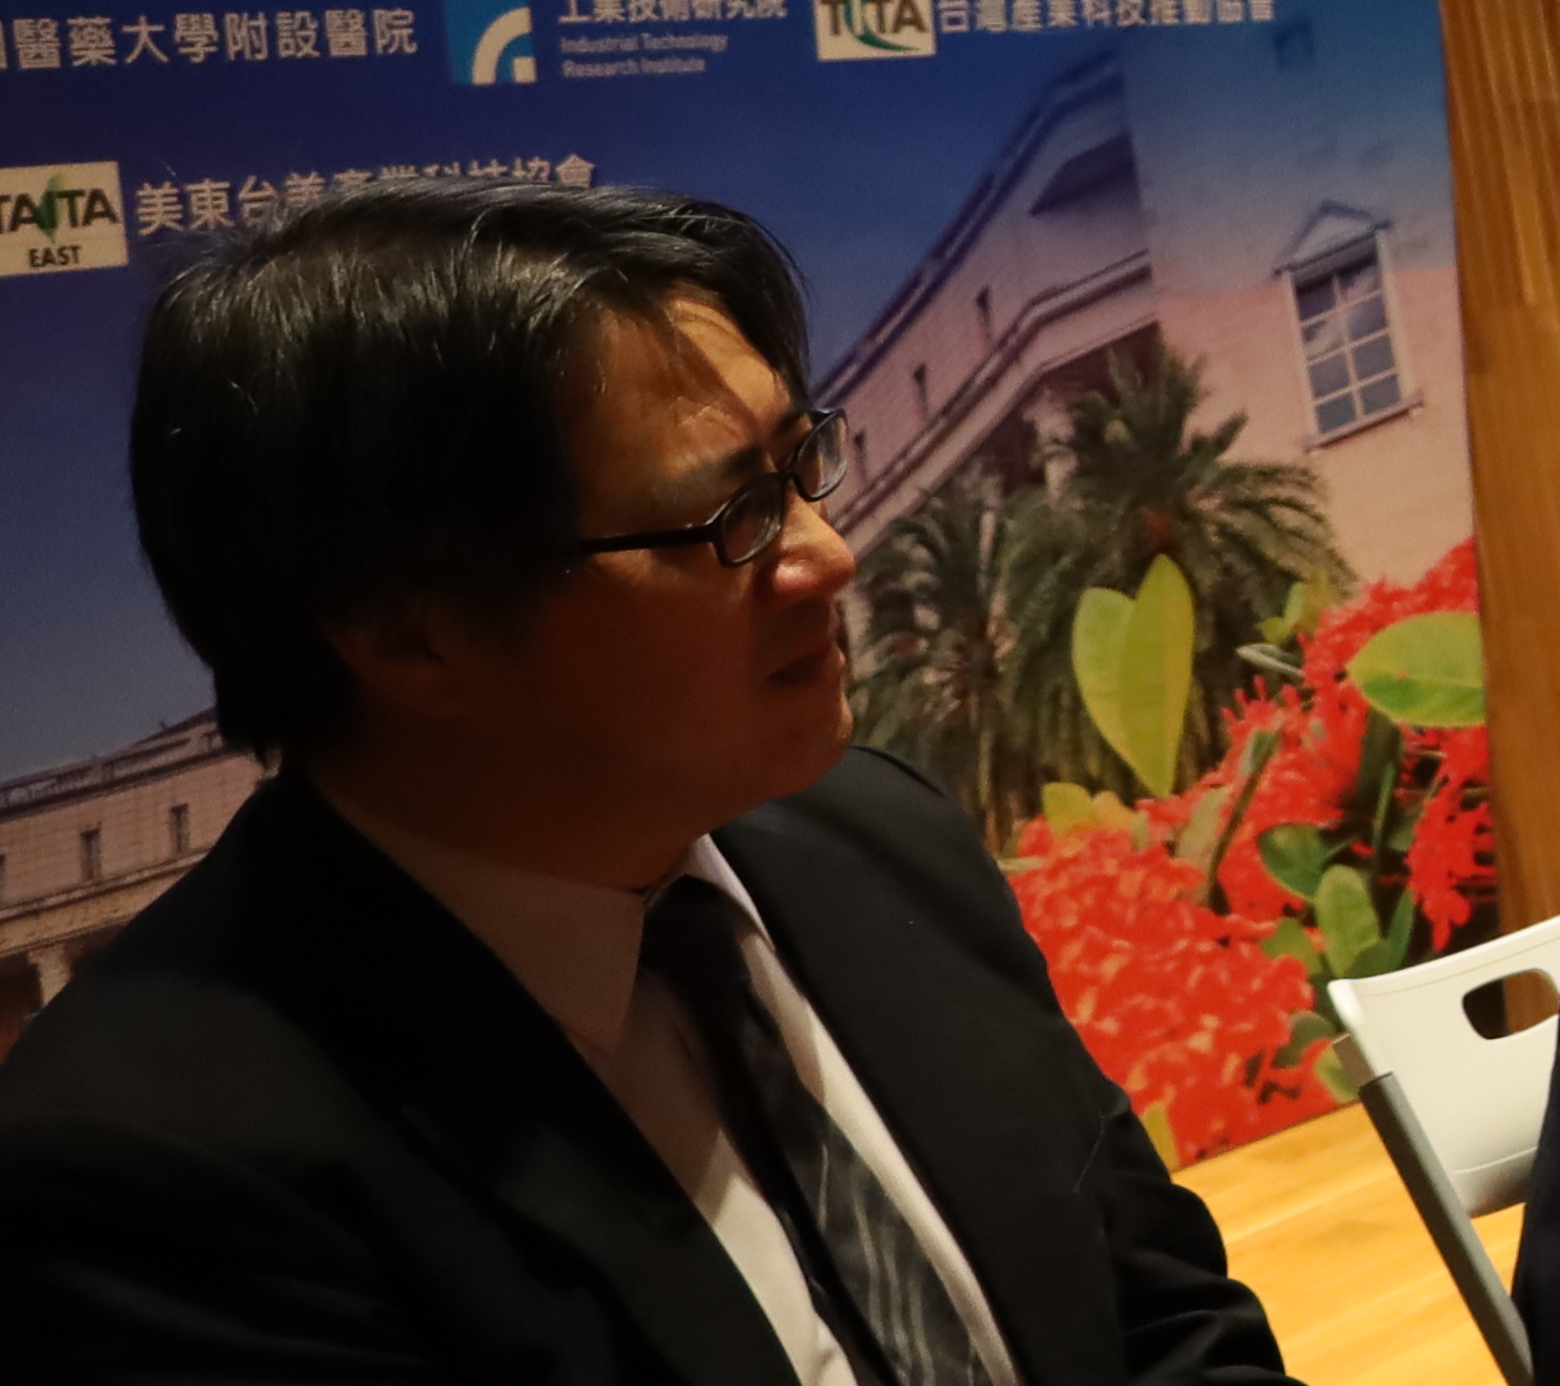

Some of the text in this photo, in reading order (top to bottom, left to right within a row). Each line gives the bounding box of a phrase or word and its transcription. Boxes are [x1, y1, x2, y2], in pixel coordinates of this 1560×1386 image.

[0, 8, 418, 69] 醫藥大學附設醫院
[28, 245, 81, 268] EAST
